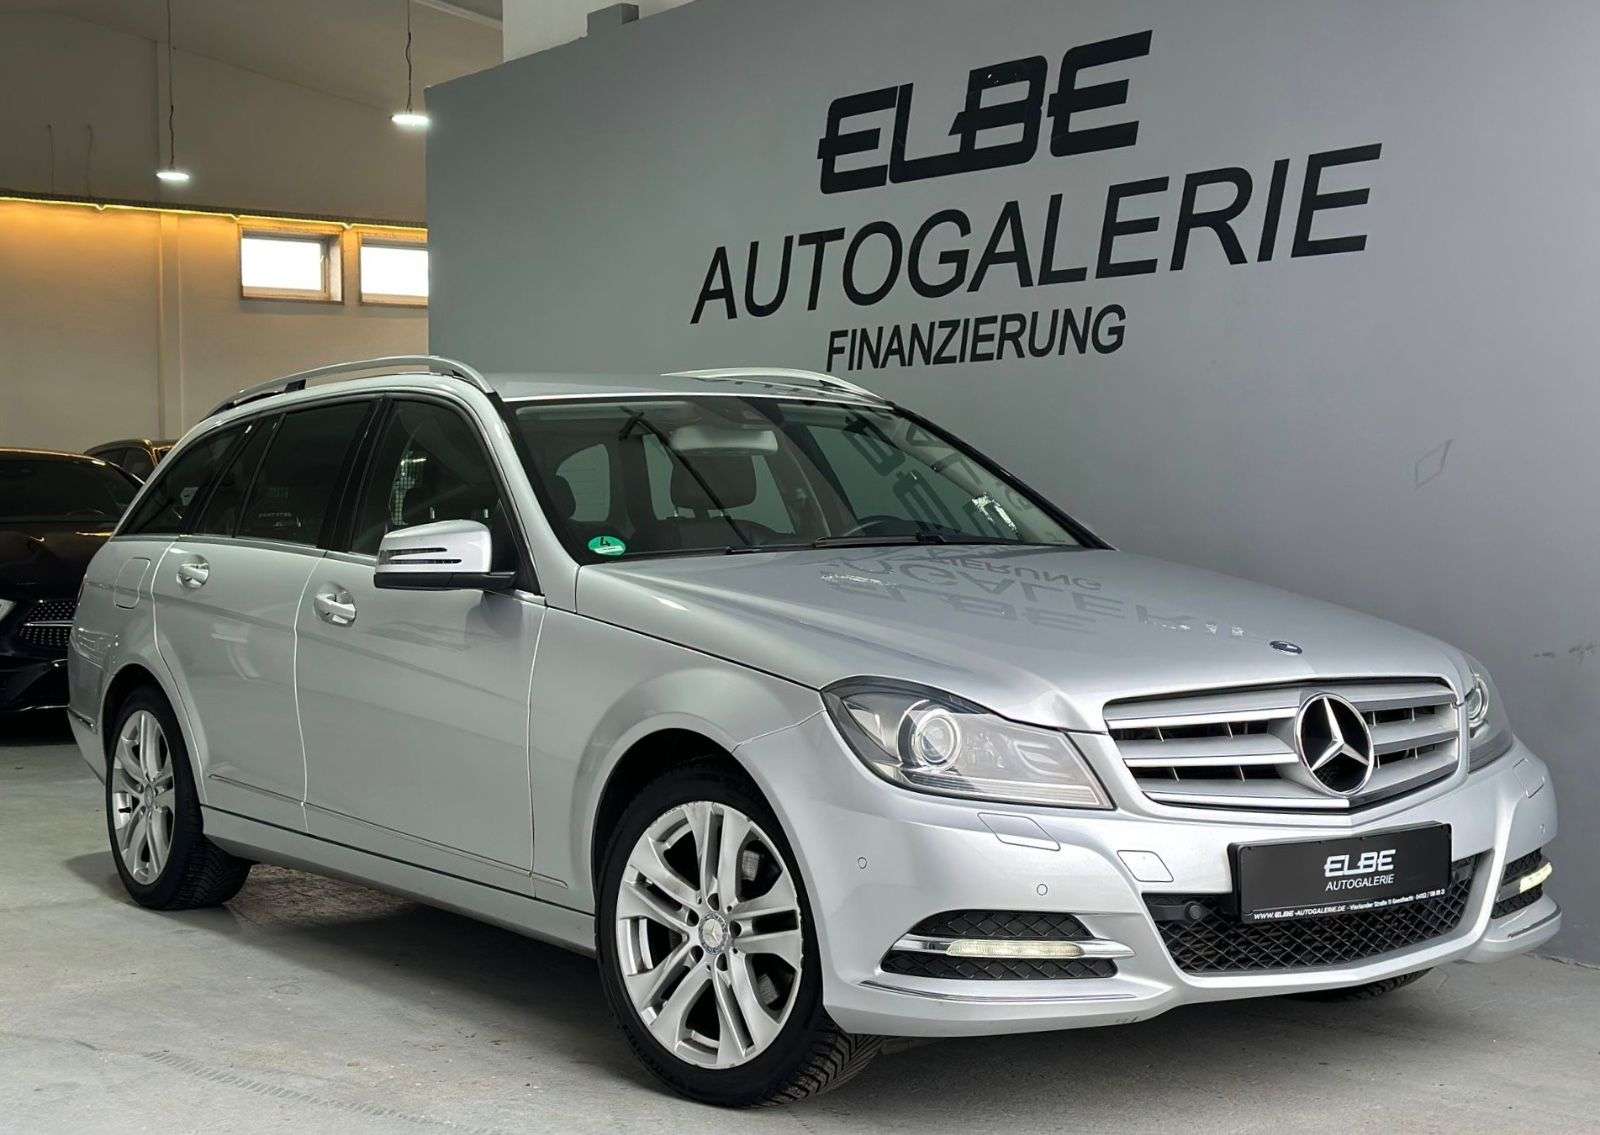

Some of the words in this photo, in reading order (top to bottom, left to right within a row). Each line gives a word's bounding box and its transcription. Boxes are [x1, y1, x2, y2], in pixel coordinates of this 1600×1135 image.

[817, 30, 1152, 194] ELBE
[690, 143, 1382, 324] AUTOGALERIE
[826, 304, 1126, 373] FINANZIERUNG
[1324, 849, 1396, 877] ELBE
[1325, 874, 1395, 892] AUTOGALERIE
